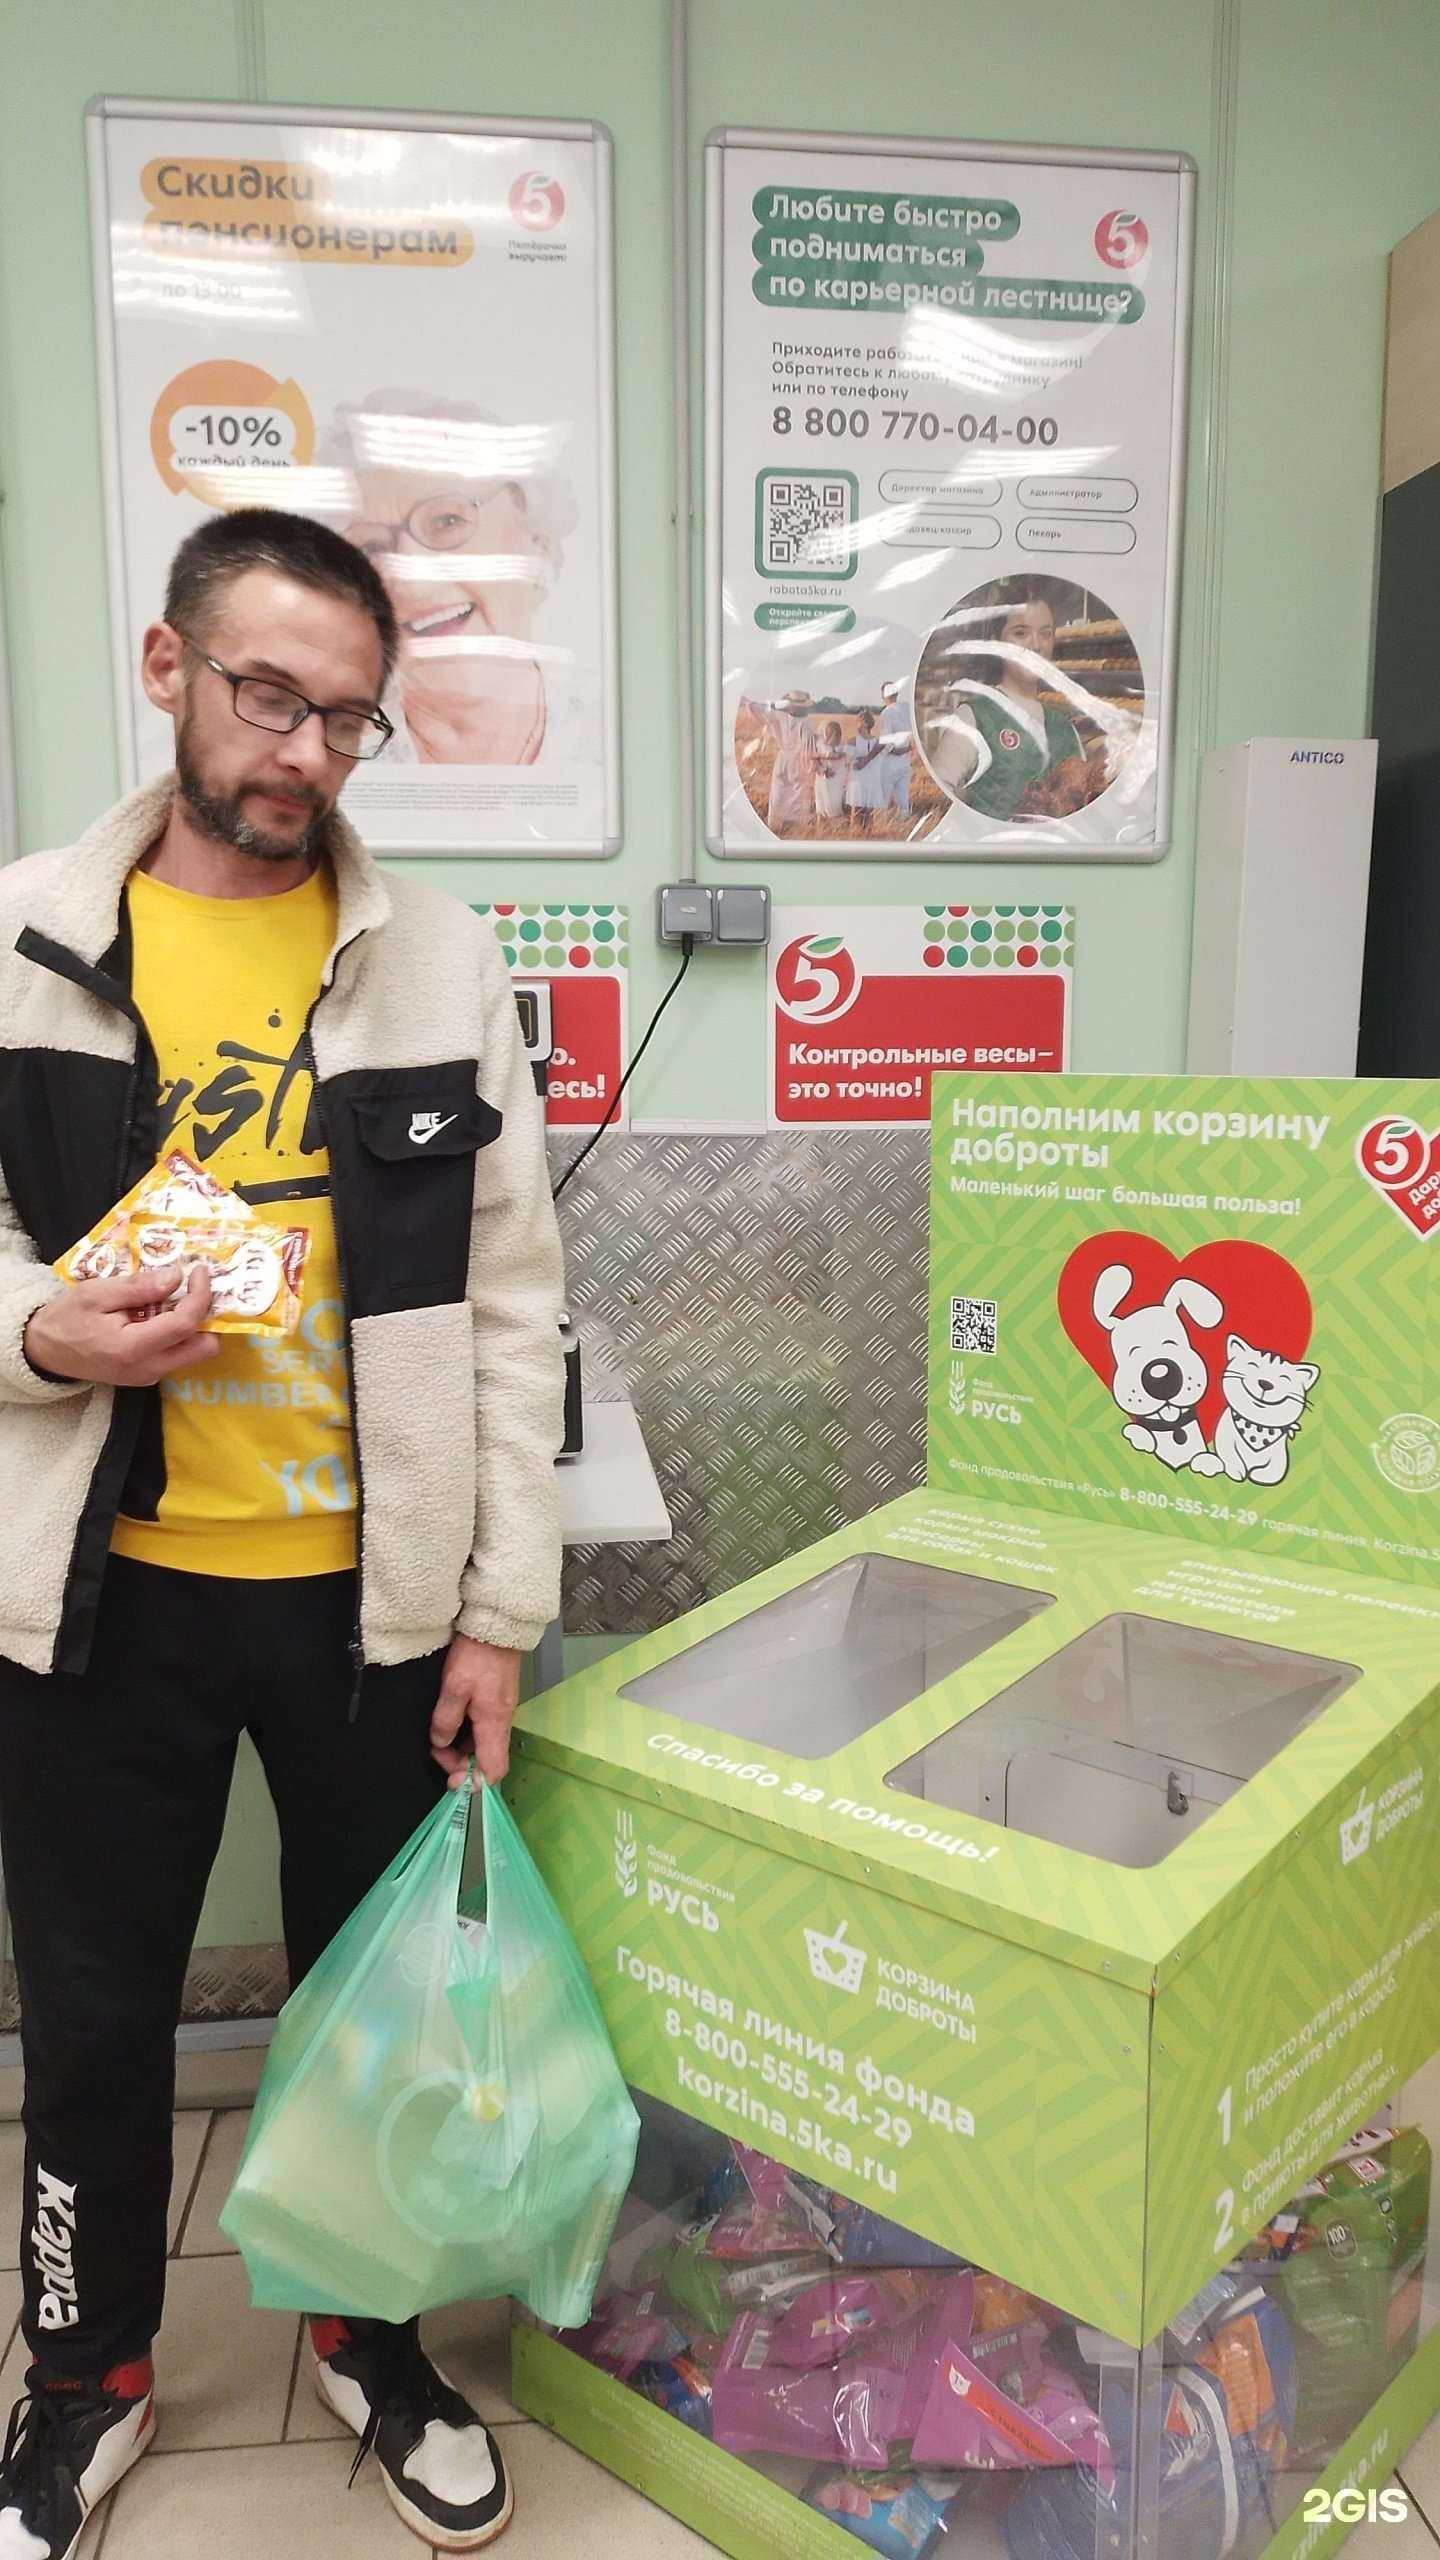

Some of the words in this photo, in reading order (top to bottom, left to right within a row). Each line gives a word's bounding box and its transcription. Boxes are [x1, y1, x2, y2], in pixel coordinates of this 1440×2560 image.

[156, 165, 315, 201] Скидки
[768, 193, 885, 225] Любите
[893, 199, 1002, 236] быстро
[159, 220, 458, 259] пенсионерам
[769, 234, 968, 268] подниматься
[769, 275, 806, 297] по
[814, 277, 976, 306] карьерной
[983, 287, 1134, 317] лестнице?
[772, 342, 862, 359] Приходите
[866, 347, 942, 362] рабо
[772, 361, 870, 380] Обратитесь
[874, 367, 883, 378] к
[772, 382, 804, 394] или
[806, 384, 826, 395] по
[830, 383, 909, 401] телефону
[185, 415, 282, 447] -10%
[772, 405, 792, 435] 8
[804, 406, 870, 438] 800
[881, 410, 1059, 446] 770-04-00
[1290, 752, 1345, 764] ANTICO
[788, 1043, 968, 1069] Контрольные
[788, 1080, 830, 1099] это
[836, 1076, 922, 1099] точно!
[951, 1098, 1140, 1134] Наполним
[1153, 1109, 1331, 1150] корзину
[950, 1133, 1108, 1171] доброты
[950, 1176, 1060, 1199] Маленький
[1065, 1186, 1106, 1202] шаг
[1112, 1186, 1207, 1210] большая
[1214, 1195, 1301, 1216] польза!
[972, 1399, 1022, 1425] РУСЬ
[949, 1458, 980, 1475] Фонд
[980, 1463, 1075, 1490] продовольствия
[1119, 1487, 1258, 1527] 8-800-555-24-29
[646, 1733, 780, 1787] Спасибо
[781, 1782, 827, 1805] за
[827, 1797, 999, 1863] помощь!
[646, 1844, 677, 1866] Фонд
[647, 1877, 720, 1933] РУСЬ
[877, 1957, 976, 2015] КОРЗИНА
[875, 1985, 977, 2043] ДОБРОТЫ
[615, 1945, 735, 2024] Горячая
[743, 2008, 845, 2075] линия
[855, 2056, 976, 2138] фонда
[1245, 2036, 1297, 2094] Просто
[1299, 1993, 1345, 2047] купите
[664, 2007, 913, 2149] 8-800-555-24-29
[1255, 2042, 1325, 2116] положите
[677, 2056, 897, 2194] korzina.5ka.ru
[1217, 2085, 1233, 2147] 1
[1242, 2144, 1281, 2193] Фонд
[1281, 2085, 1345, 2158] доставит
[1213, 2187, 1235, 2255] 2
[31, 2162, 80, 2331] Kappa
